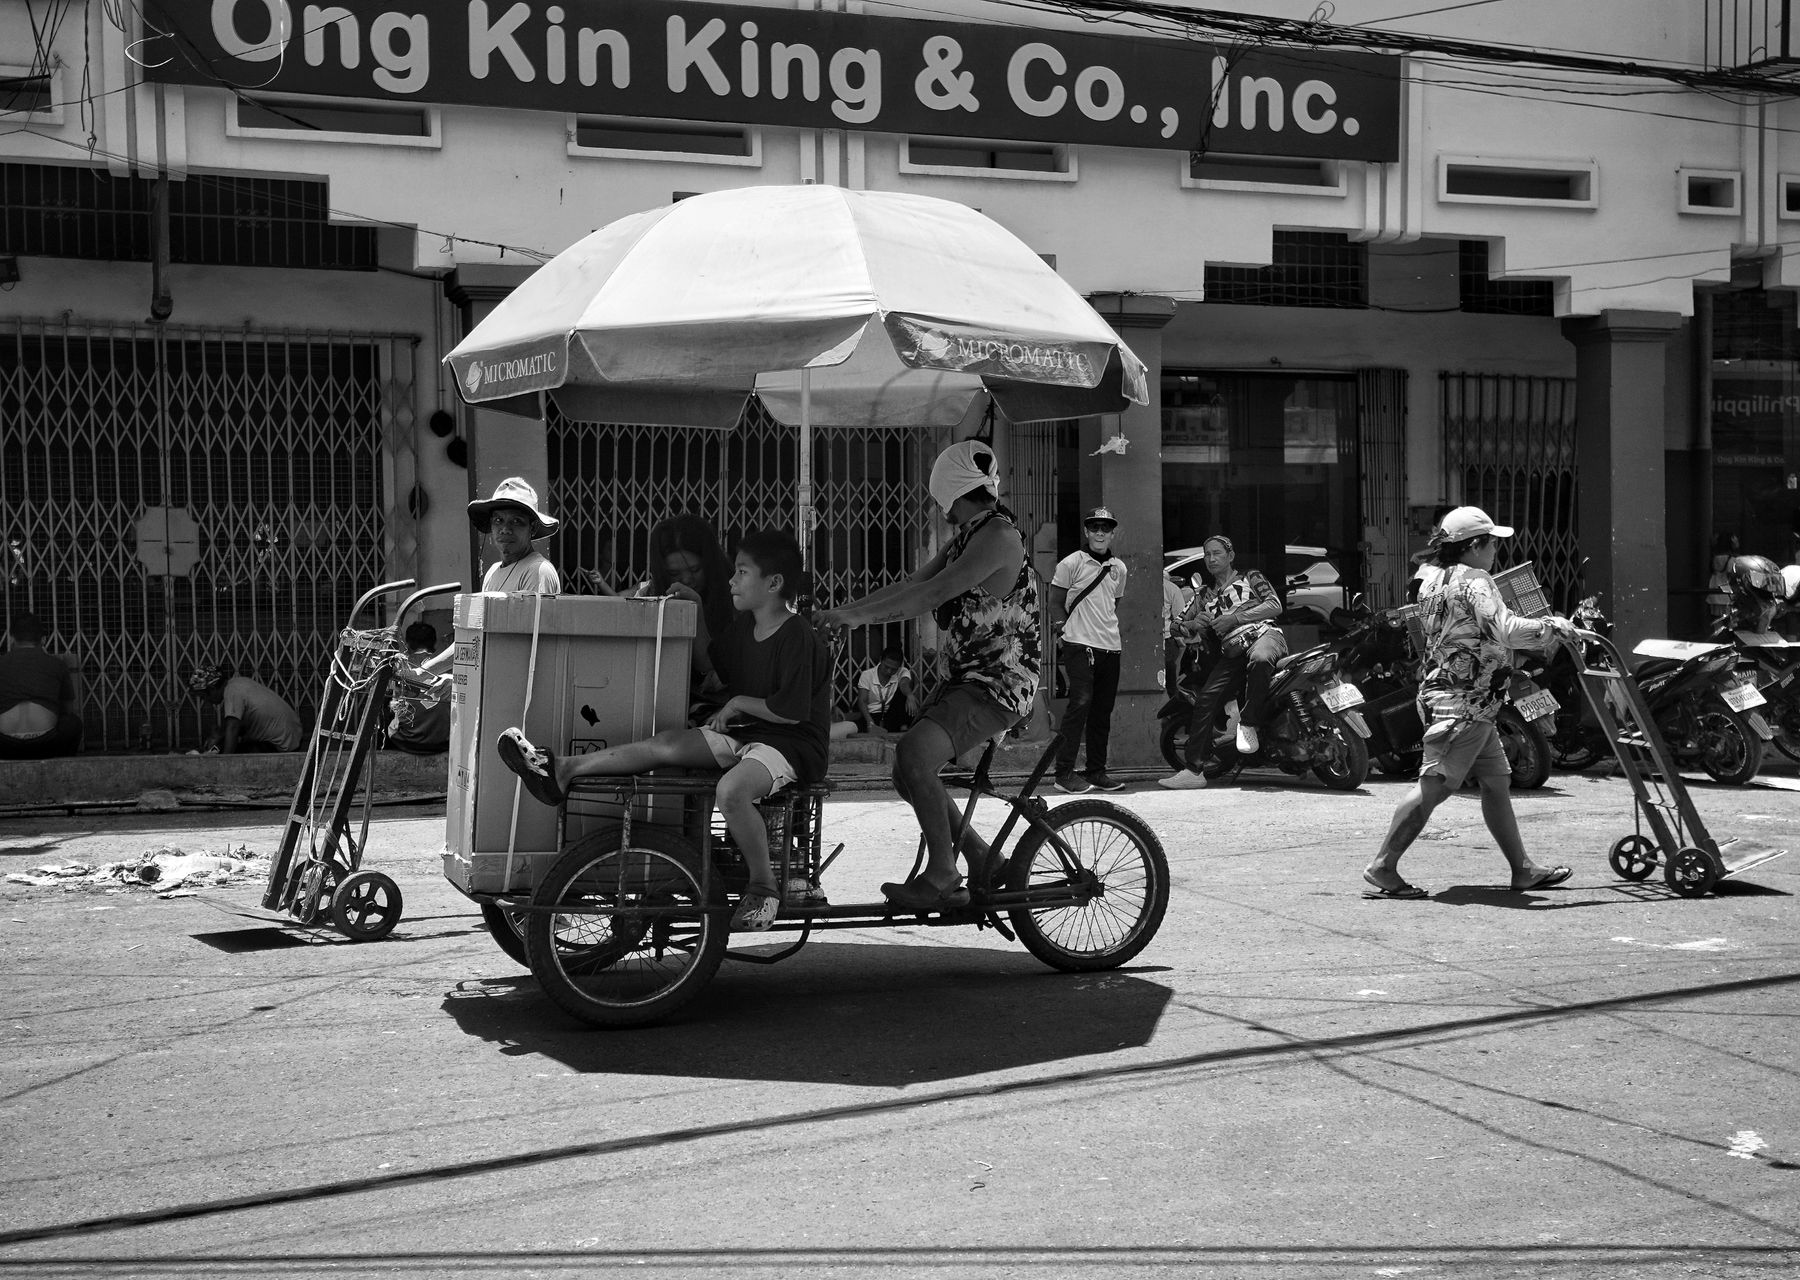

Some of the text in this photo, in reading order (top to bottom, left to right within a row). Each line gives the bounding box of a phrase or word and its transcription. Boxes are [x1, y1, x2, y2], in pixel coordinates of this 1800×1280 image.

[212, 0, 1360, 138] Ong Kin King & Co., Inc.
[484, 351, 556, 385] MICROMATIC
[957, 337, 1088, 373] MICROMATIC
